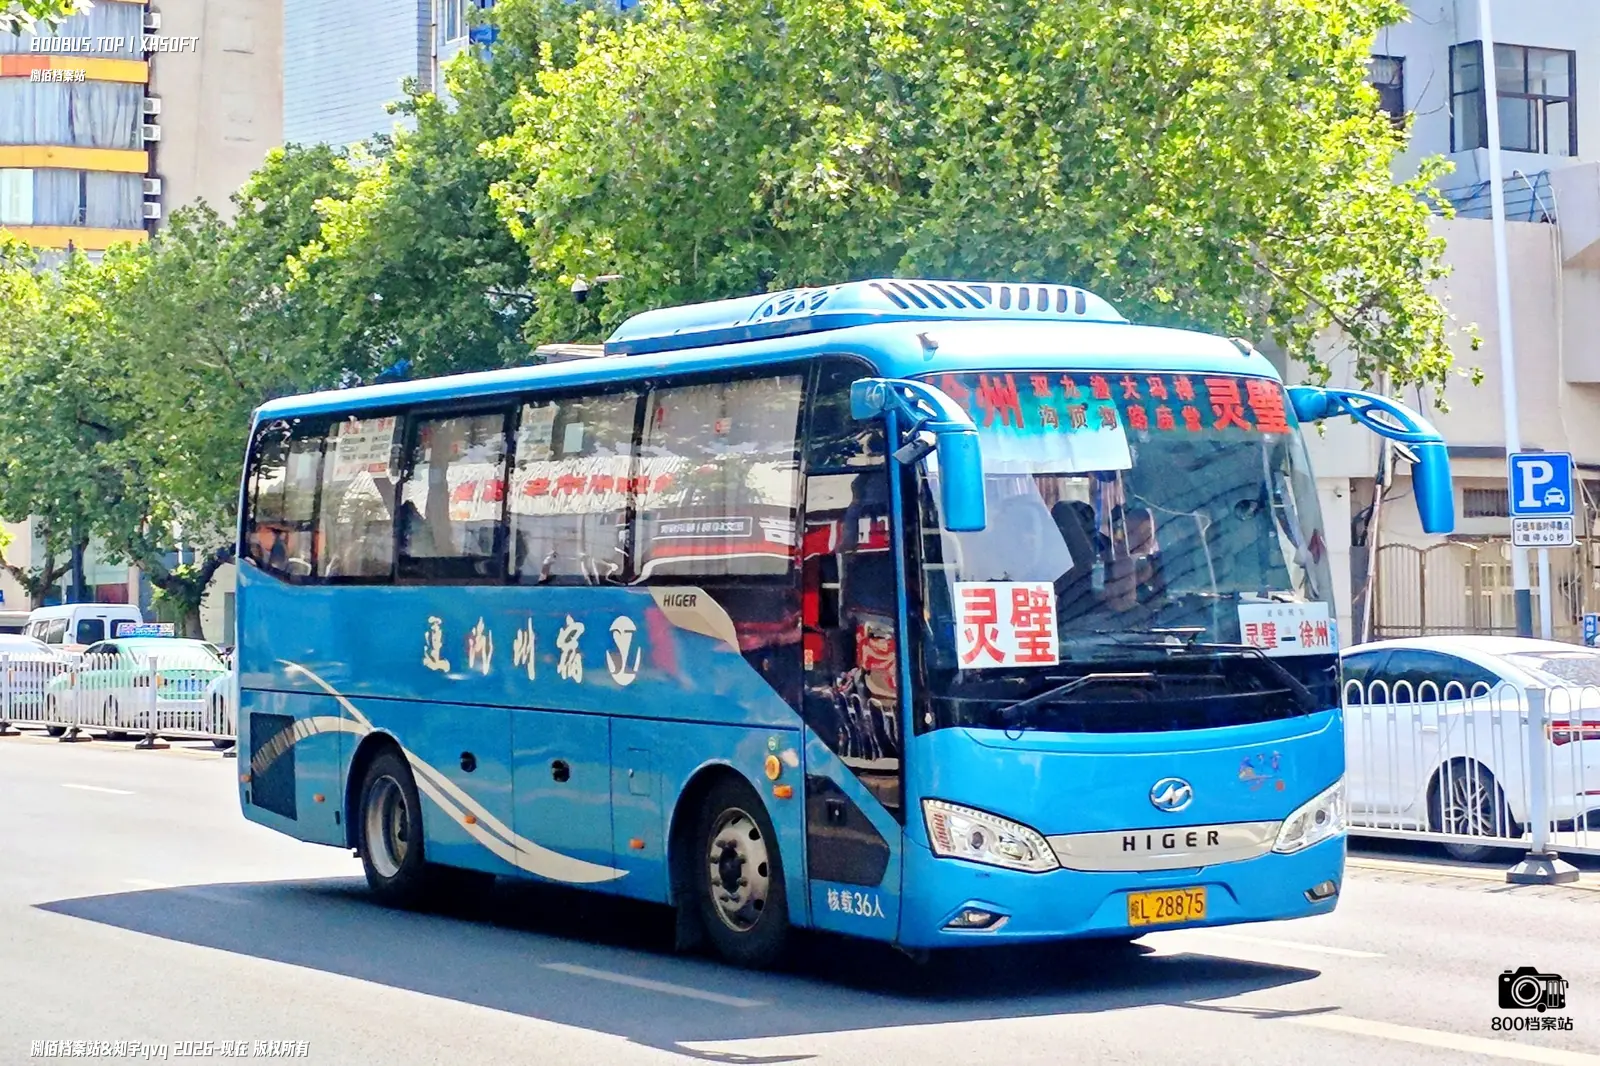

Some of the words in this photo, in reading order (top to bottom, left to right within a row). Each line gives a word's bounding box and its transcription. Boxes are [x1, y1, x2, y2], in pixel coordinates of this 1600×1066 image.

[1204, 377, 1292, 434] 灵璧
[1517, 460, 1553, 507] P
[663, 594, 697, 607] HIGER
[961, 585, 1056, 664] 灵璧
[1122, 831, 1219, 851] HIGER
[827, 888, 886, 919] 核载36人
